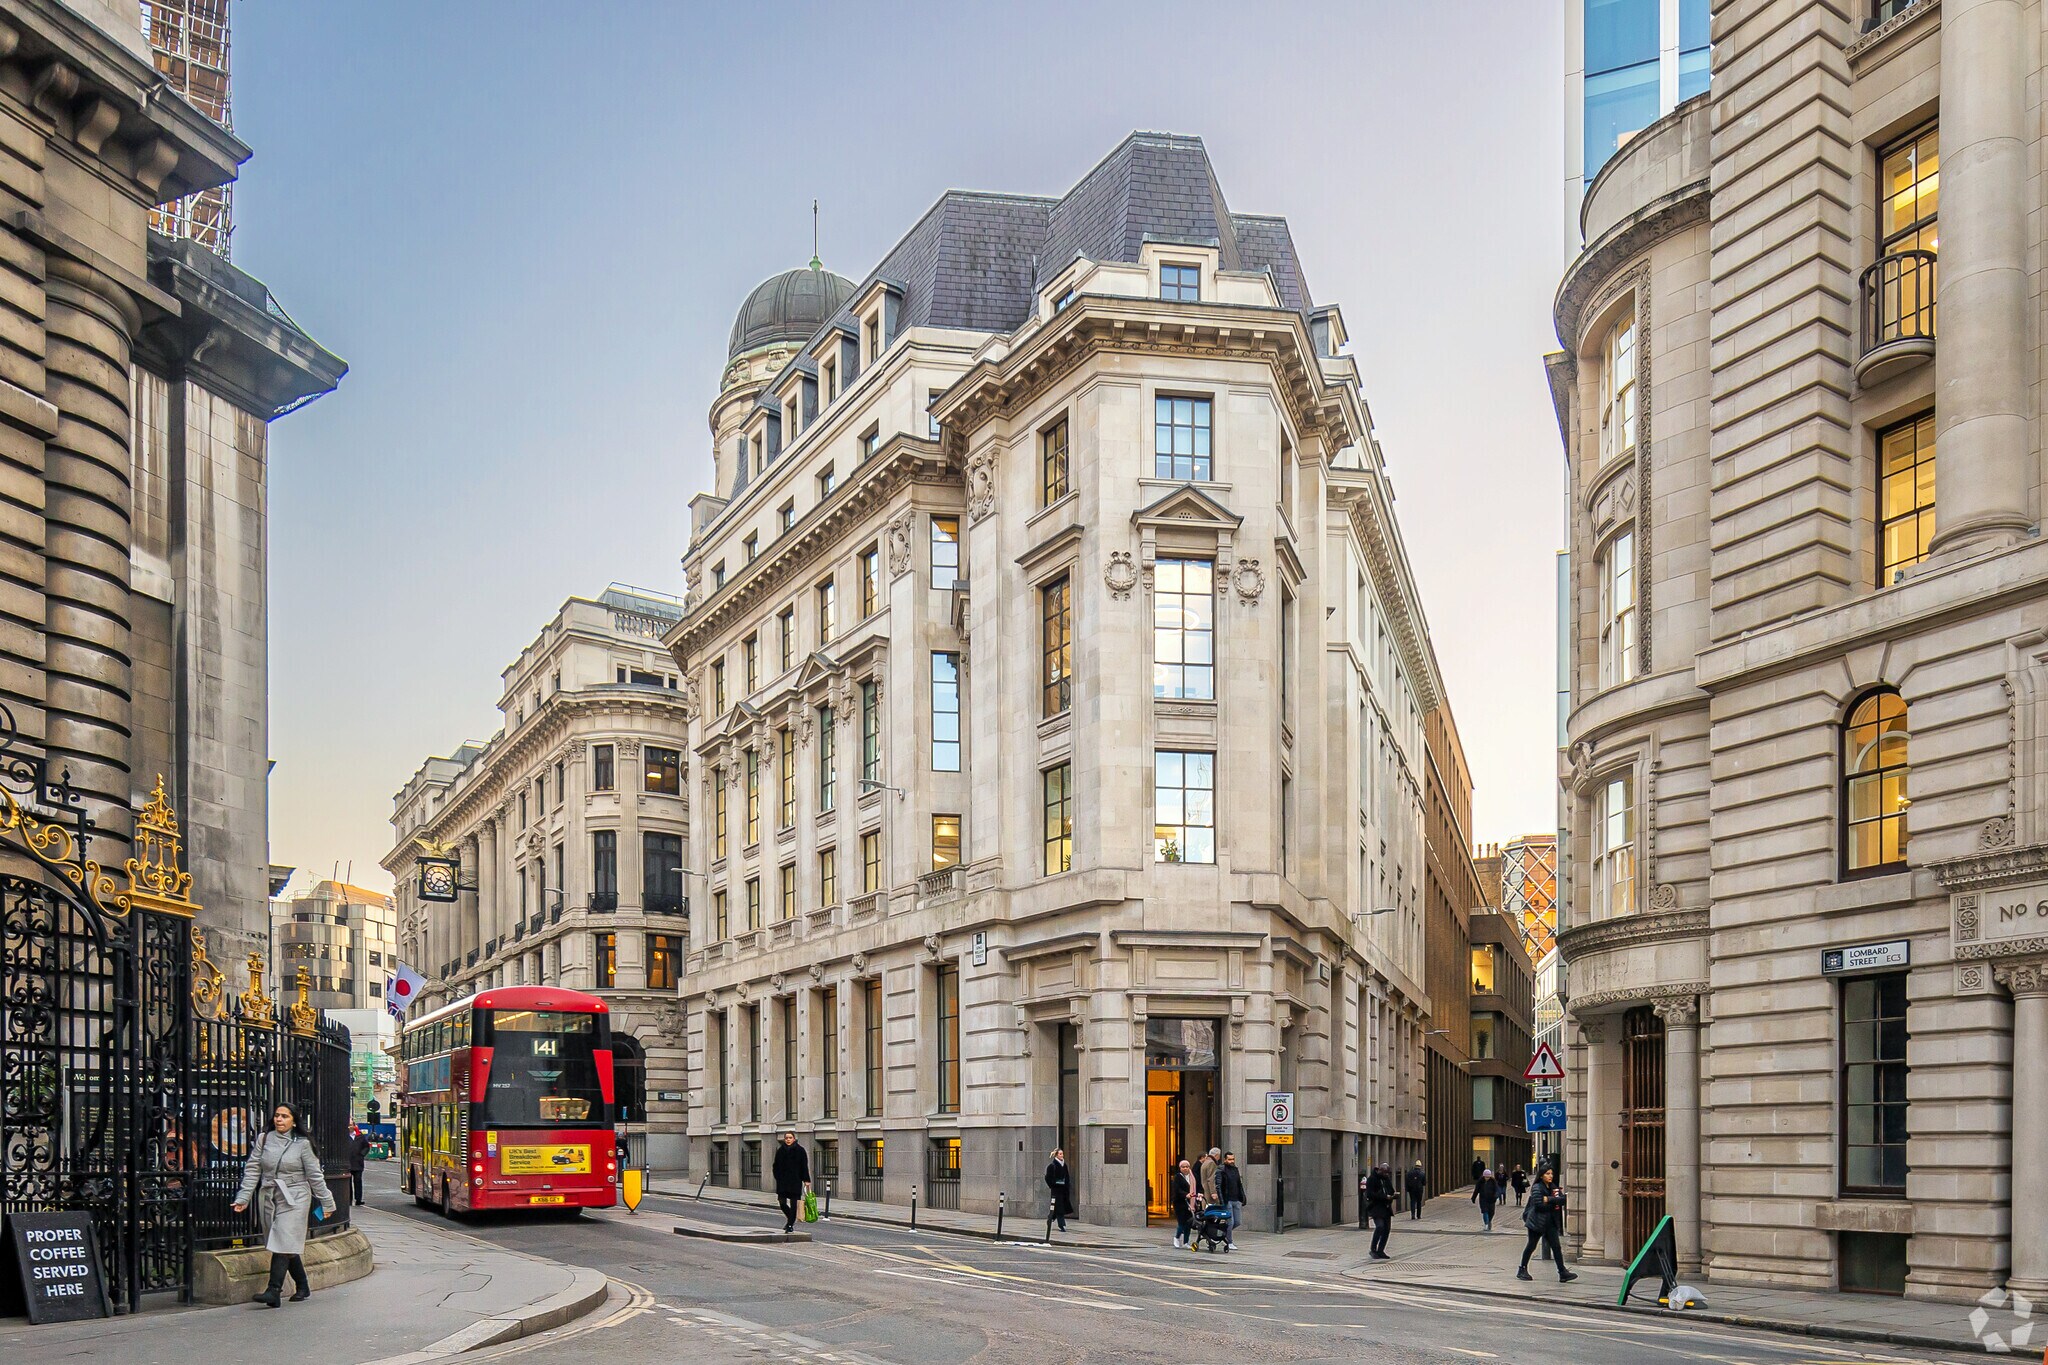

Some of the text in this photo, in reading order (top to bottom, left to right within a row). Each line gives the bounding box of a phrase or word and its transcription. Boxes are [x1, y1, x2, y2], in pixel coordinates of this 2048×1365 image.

[1849, 947, 1889, 958] LOMBARD
[1849, 953, 1902, 966] STREET EC3
[533, 1040, 556, 1055] 141
[26, 1229, 82, 1242] PROPER
[30, 1246, 86, 1261] COFFEE
[33, 1265, 89, 1279] SERVED
[46, 1283, 84, 1297] HERE
